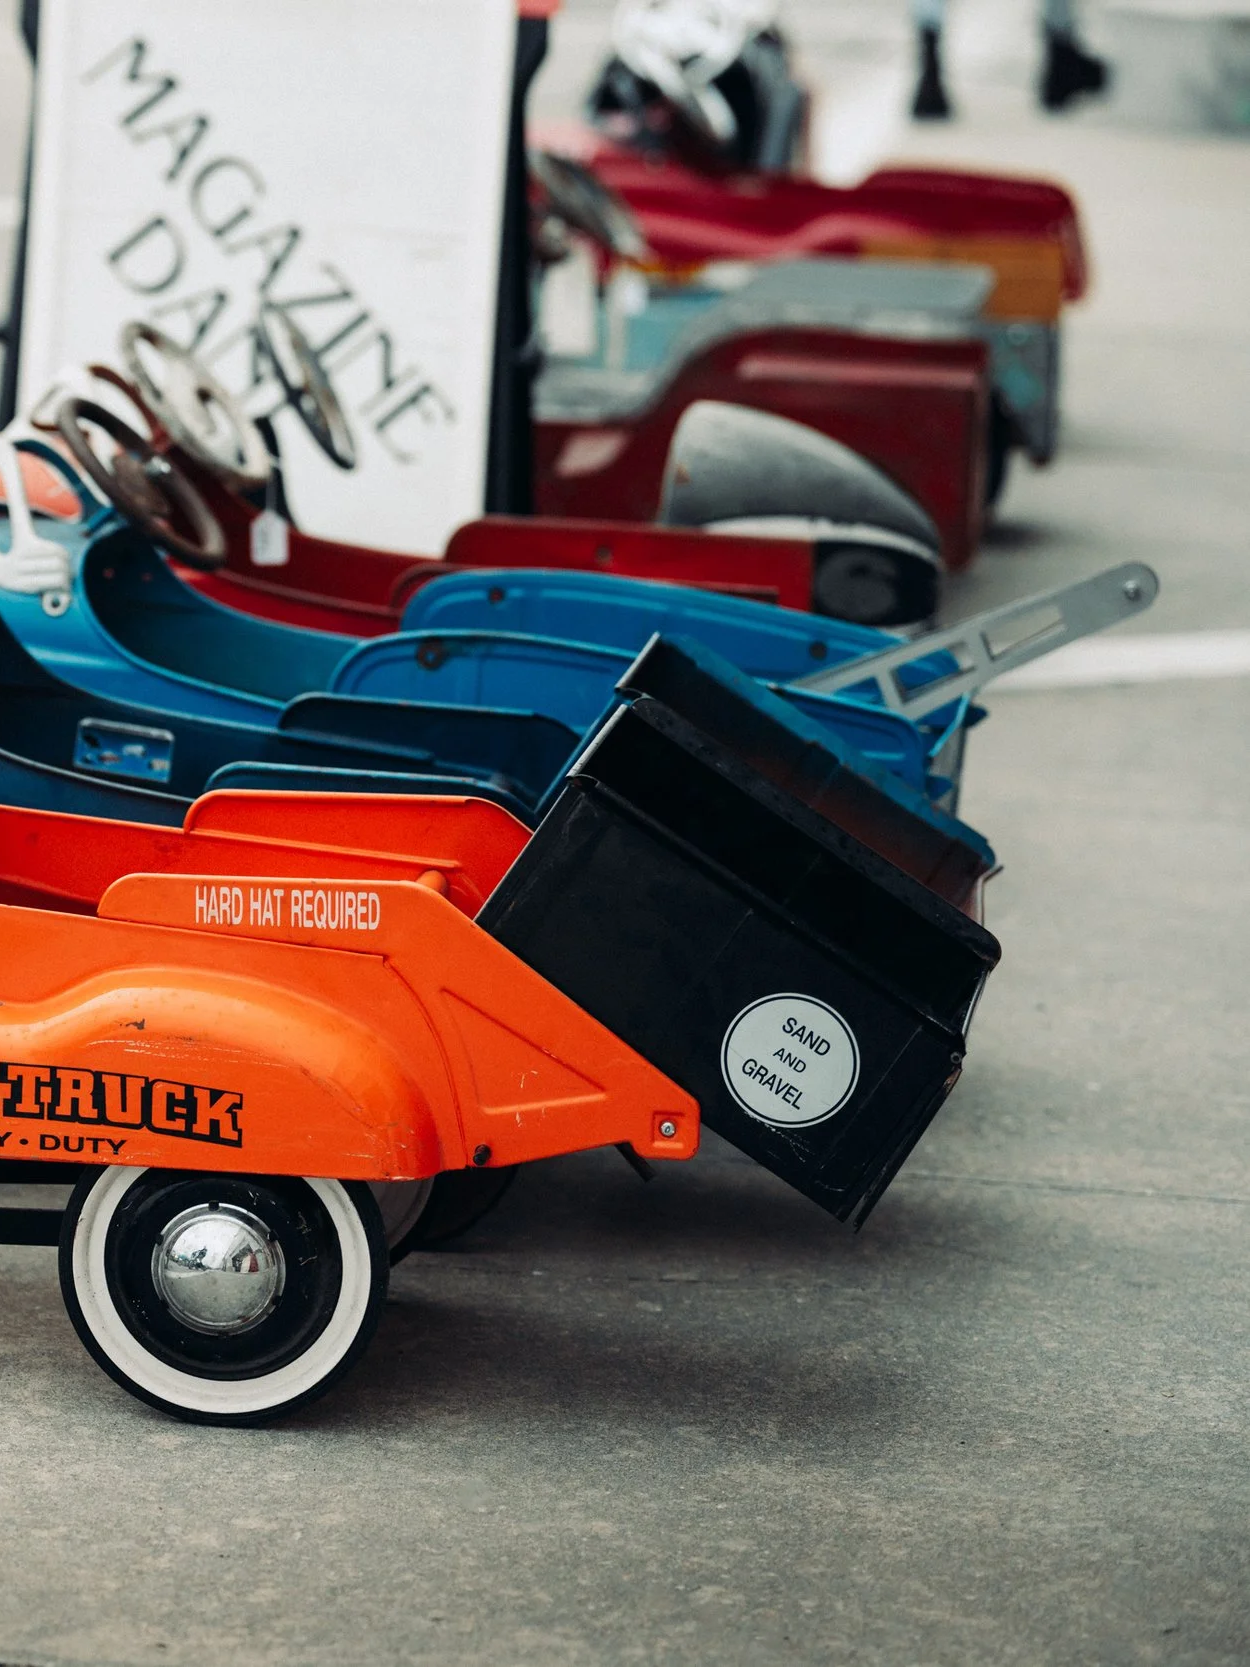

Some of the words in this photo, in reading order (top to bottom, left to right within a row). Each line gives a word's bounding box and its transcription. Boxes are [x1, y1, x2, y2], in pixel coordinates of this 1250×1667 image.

[81, 35, 457, 466] MAGAZINE
[195, 885, 244, 925] HARD
[250, 887, 285, 927] HAT
[291, 889, 381, 930] REQUIRED
[782, 1017, 831, 1056] SAND
[772, 1047, 807, 1074] AND
[742, 1058, 804, 1110] GRAVEL
[39, 1133, 127, 1156] DUTY
